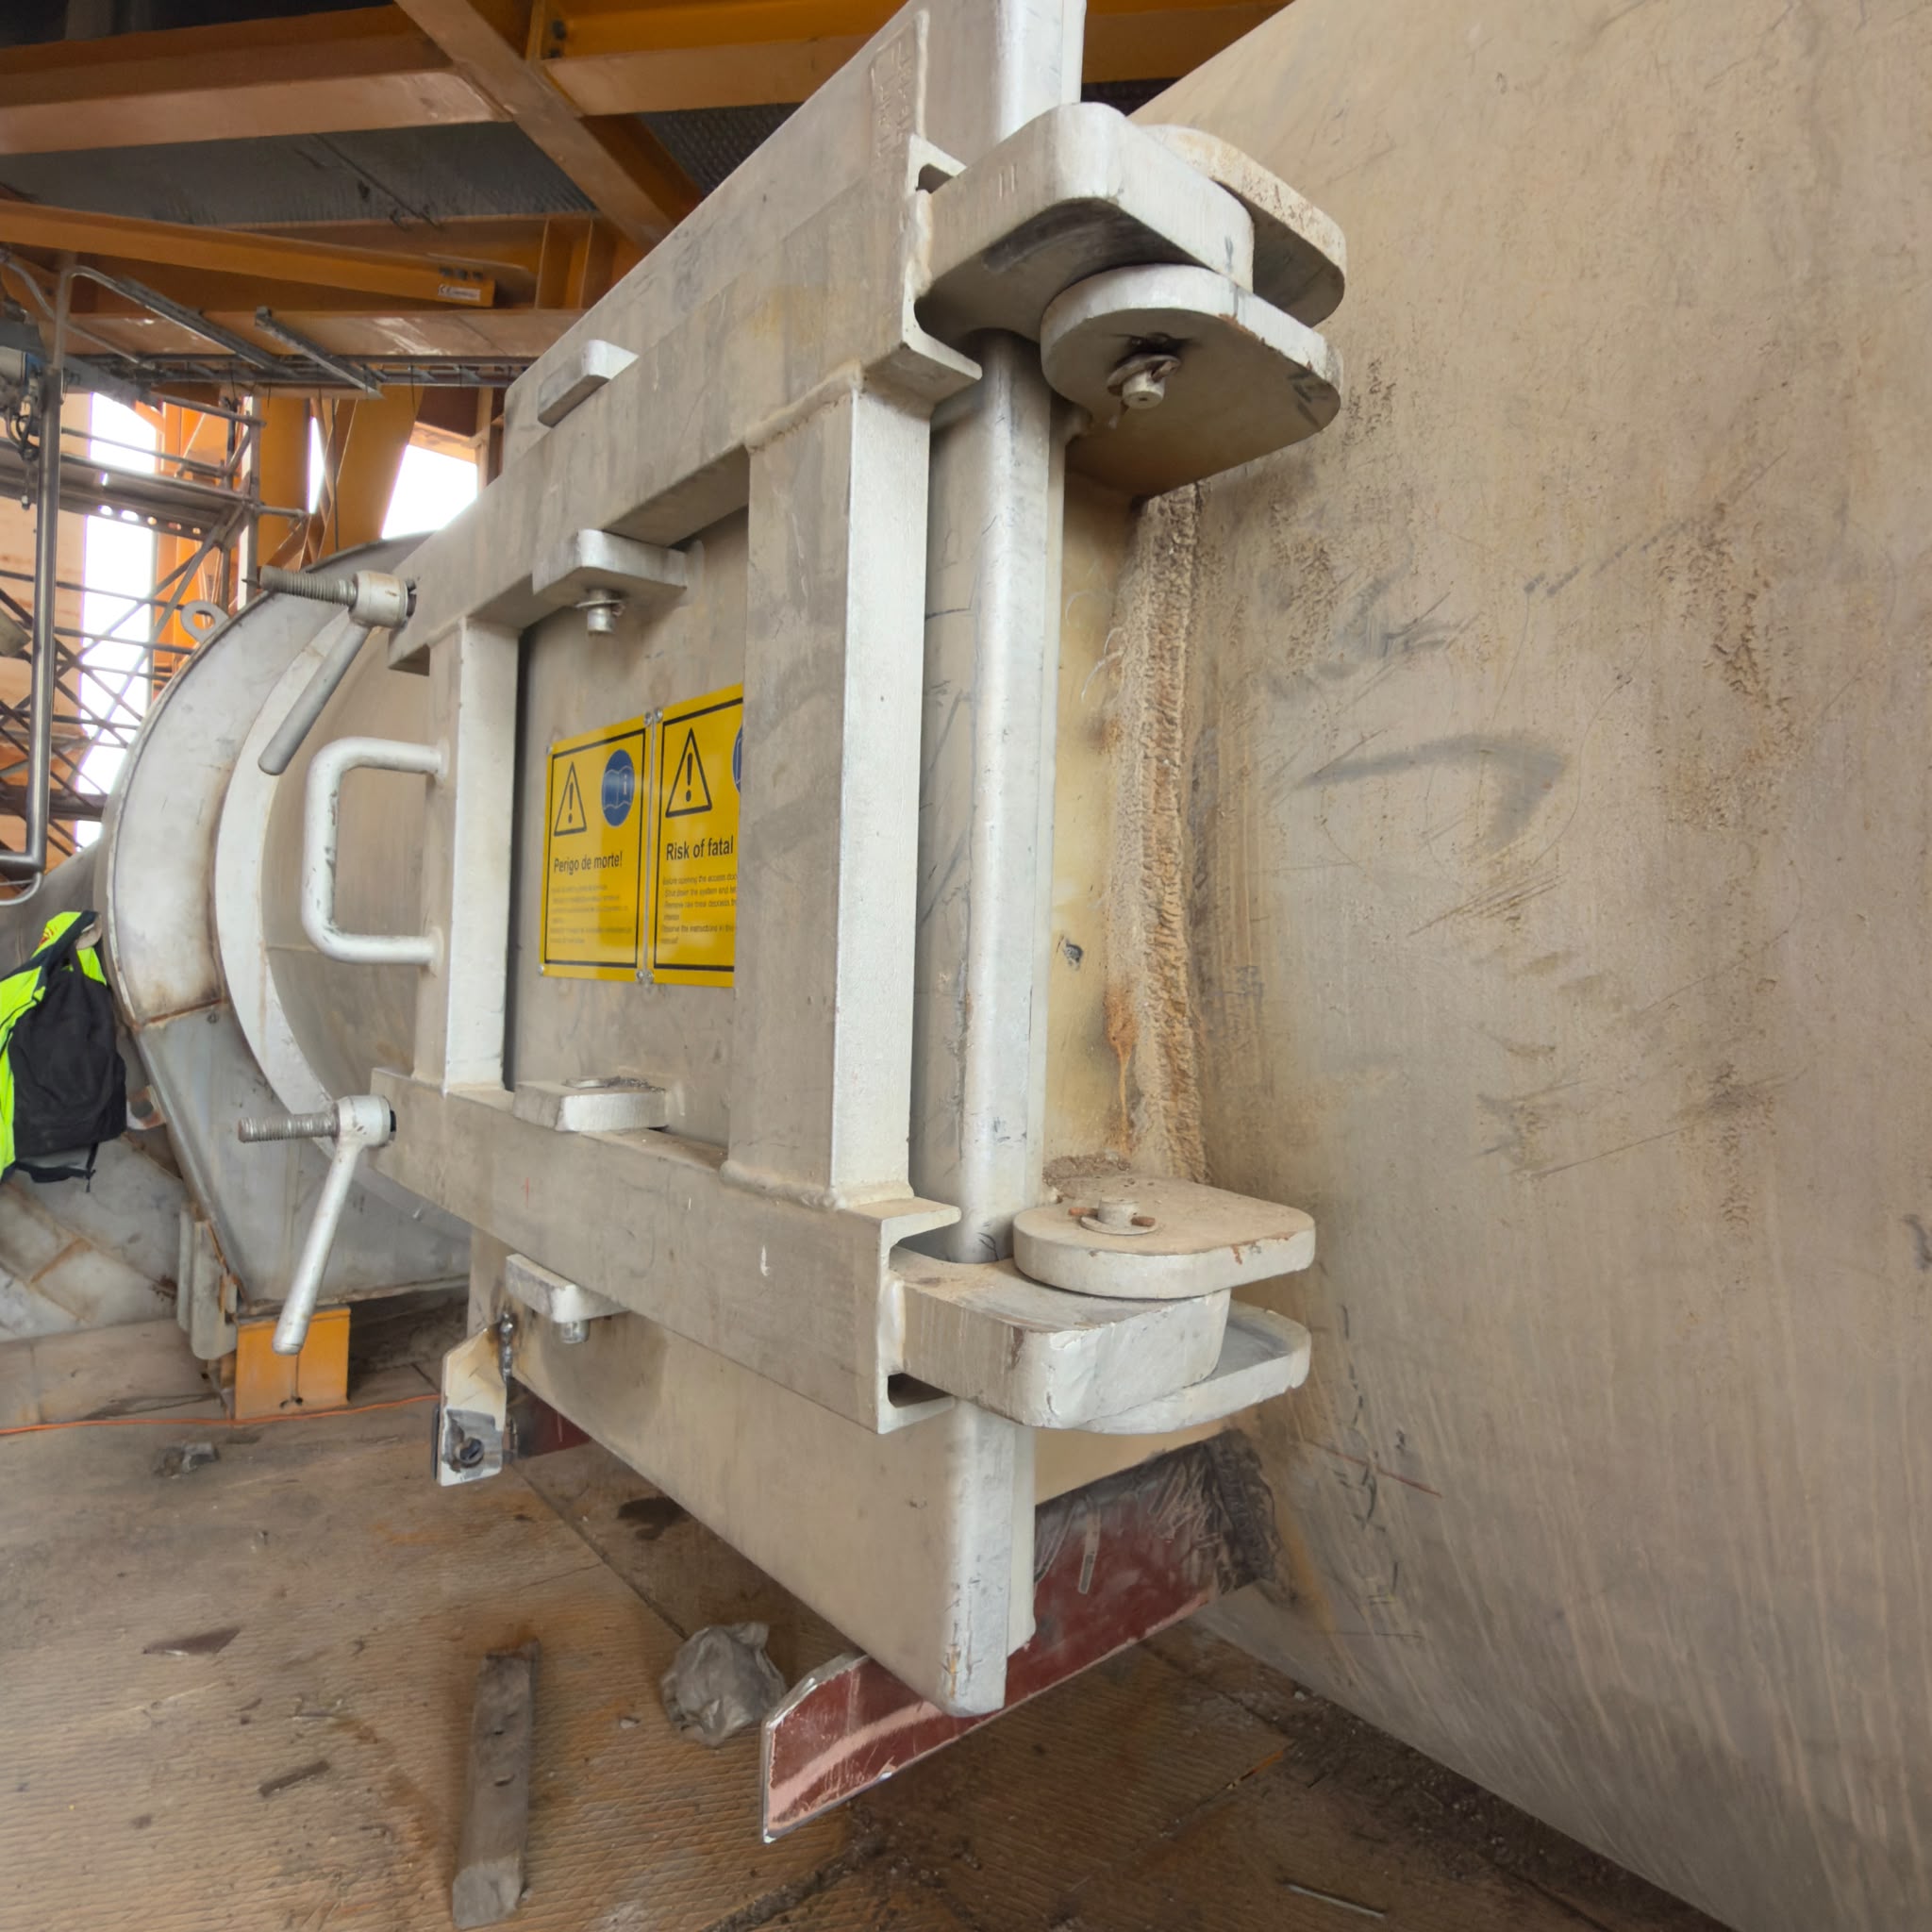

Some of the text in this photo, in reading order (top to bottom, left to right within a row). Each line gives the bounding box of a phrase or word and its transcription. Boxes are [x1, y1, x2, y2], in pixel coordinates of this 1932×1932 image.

[666, 835, 734, 860] Risk of fatal
[554, 850, 623, 875] Perigo de morte!
